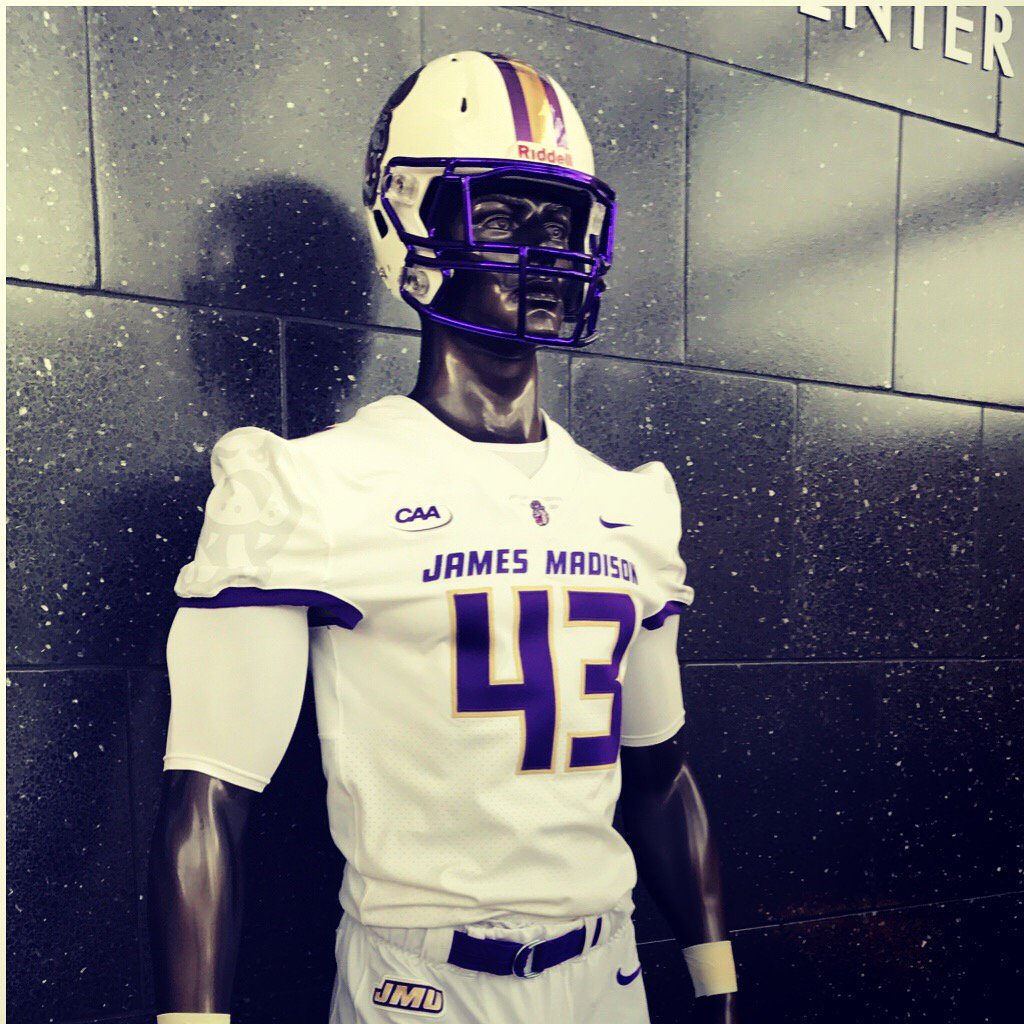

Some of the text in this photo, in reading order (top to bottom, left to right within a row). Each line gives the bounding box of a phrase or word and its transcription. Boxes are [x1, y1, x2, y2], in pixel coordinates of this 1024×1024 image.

[518, 145, 574, 166] Riddell
[395, 506, 440, 524] CAA
[422, 549, 638, 585] JAMES MADISON
[446, 585, 637, 775] 43
[373, 979, 444, 1014] JMU
